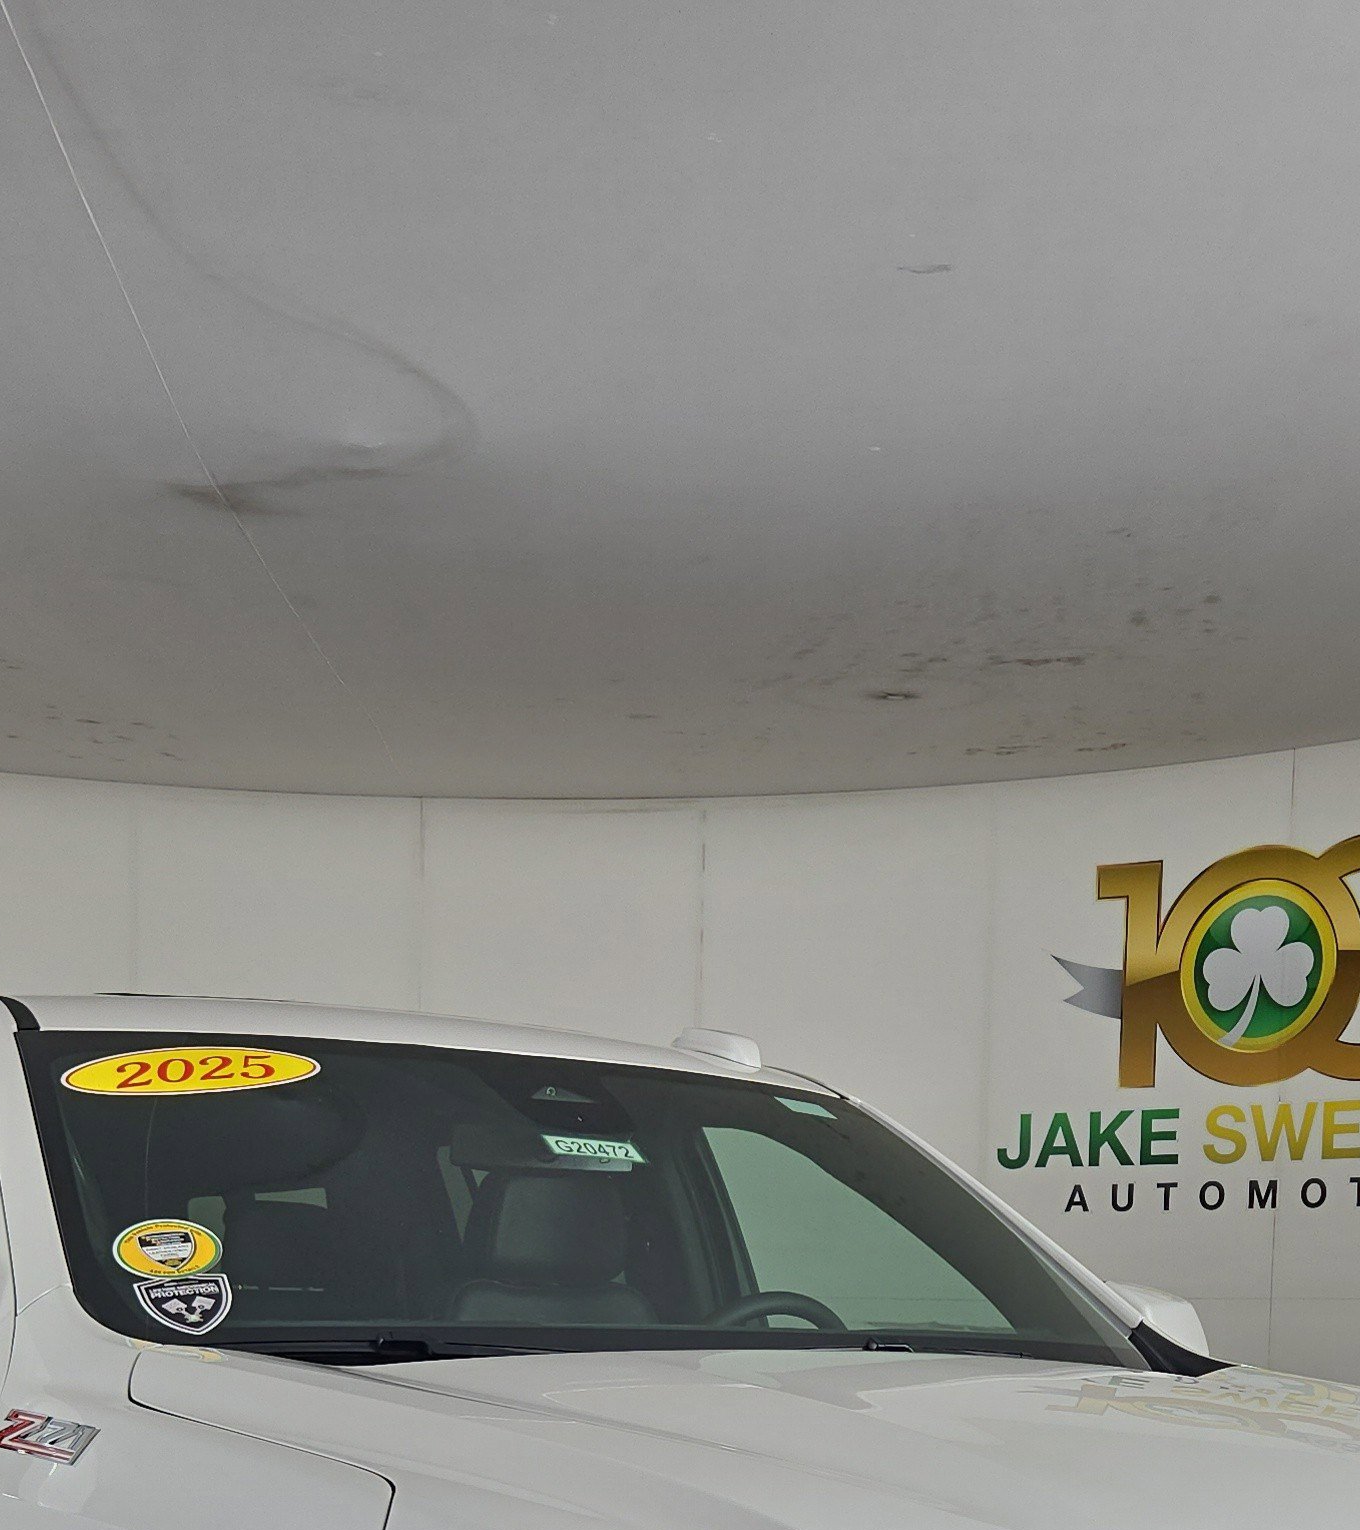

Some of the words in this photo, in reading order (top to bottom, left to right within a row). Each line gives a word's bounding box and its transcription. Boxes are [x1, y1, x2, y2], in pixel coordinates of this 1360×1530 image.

[117, 1053, 276, 1090] 2025
[554, 1138, 635, 1159] G20472
[997, 1108, 1180, 1170] JAKE
